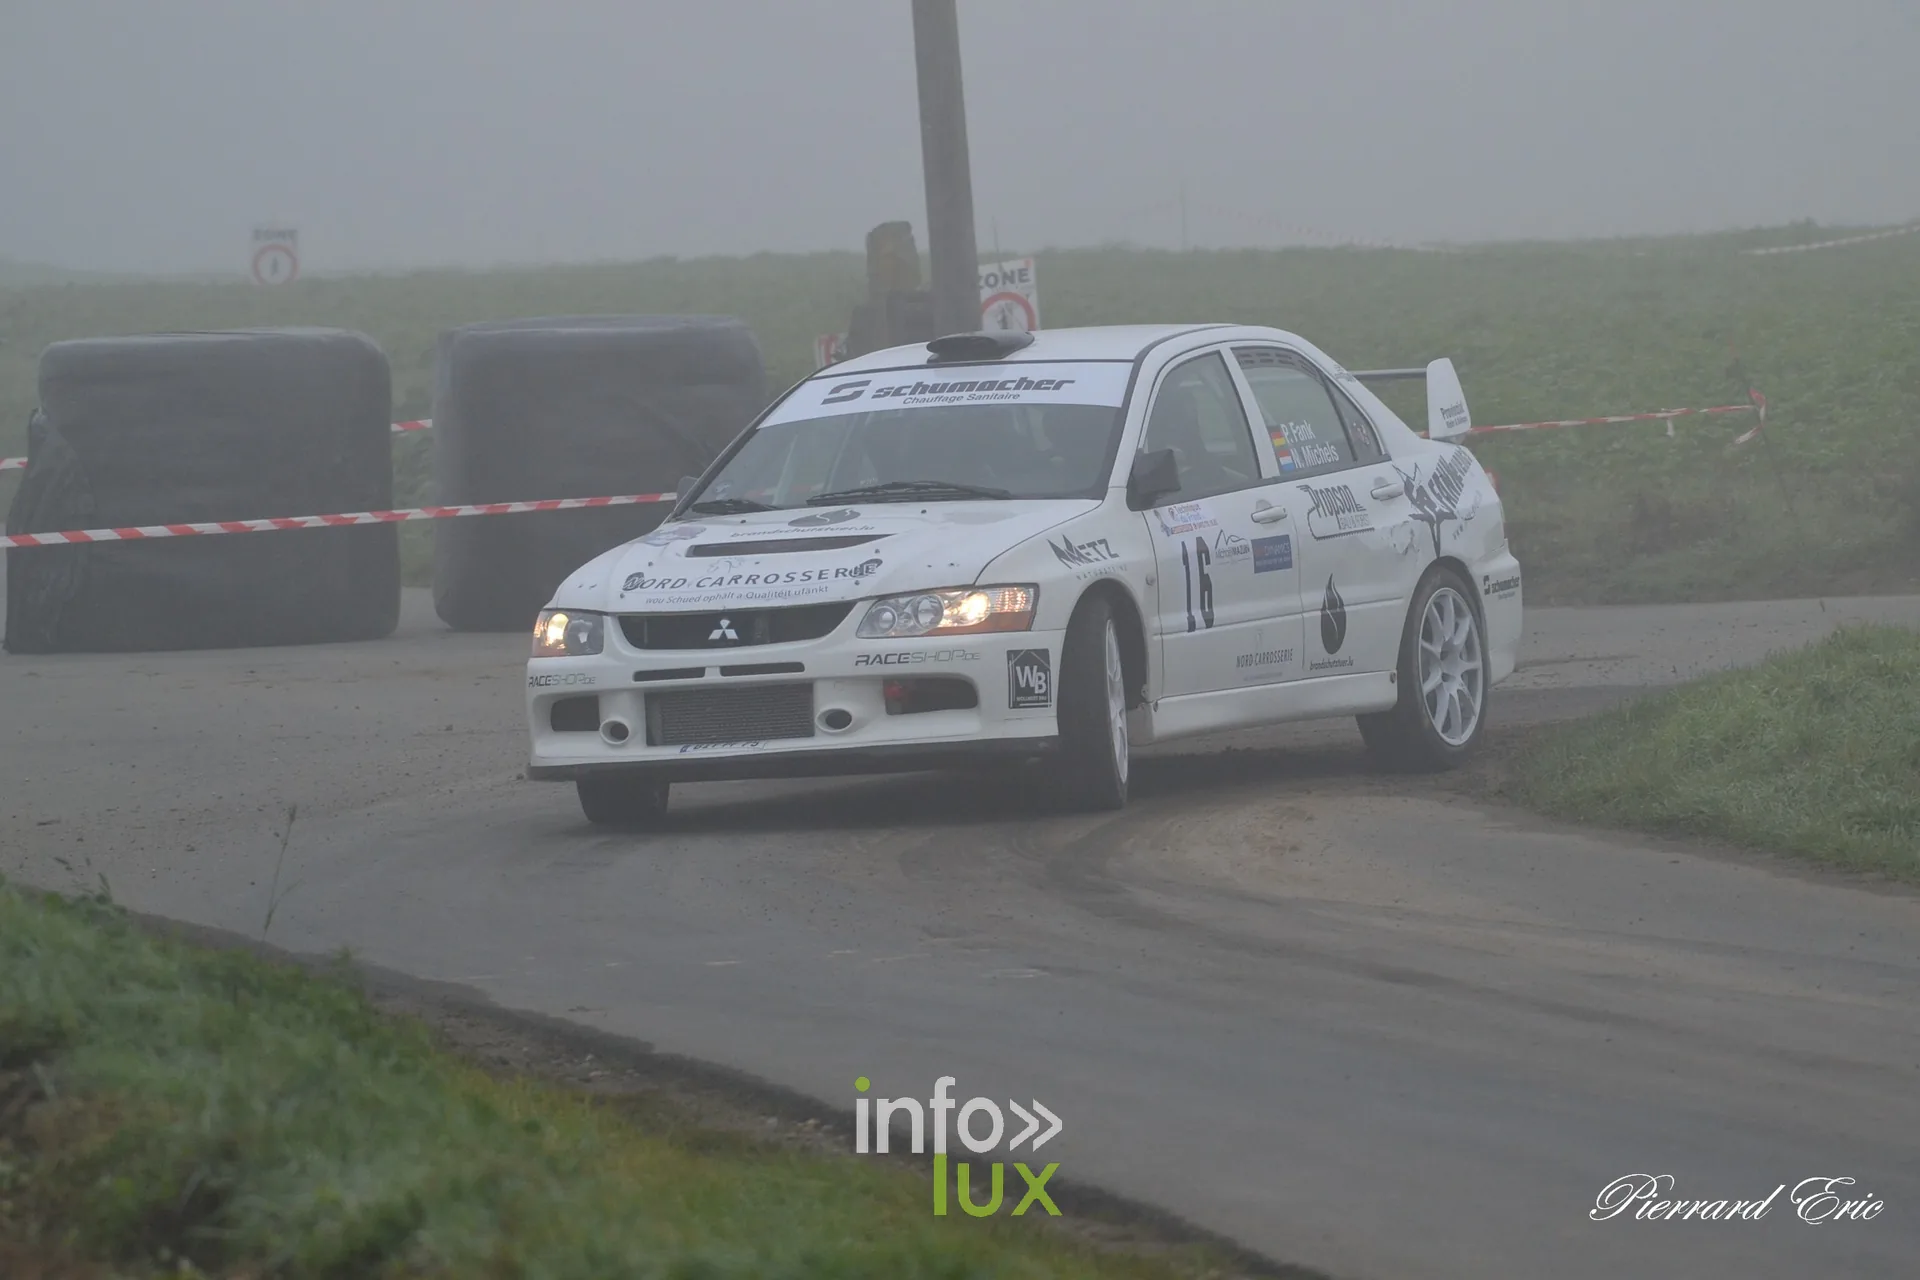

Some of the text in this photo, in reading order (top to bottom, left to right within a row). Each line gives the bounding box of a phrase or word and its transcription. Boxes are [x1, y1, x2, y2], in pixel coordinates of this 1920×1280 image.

[871, 376, 1075, 399] schumacher
[903, 391, 1020, 405] Chauffage Sanitaire
[1302, 441, 1339, 467] Michels
[1046, 534, 1119, 569] METZ
[622, 564, 878, 591] NORD CARROSSERIE
[1181, 536, 1215, 633] 16
[1236, 648, 1293, 668] NORD CARROSSERIE
[1016, 666, 1047, 694] WB
